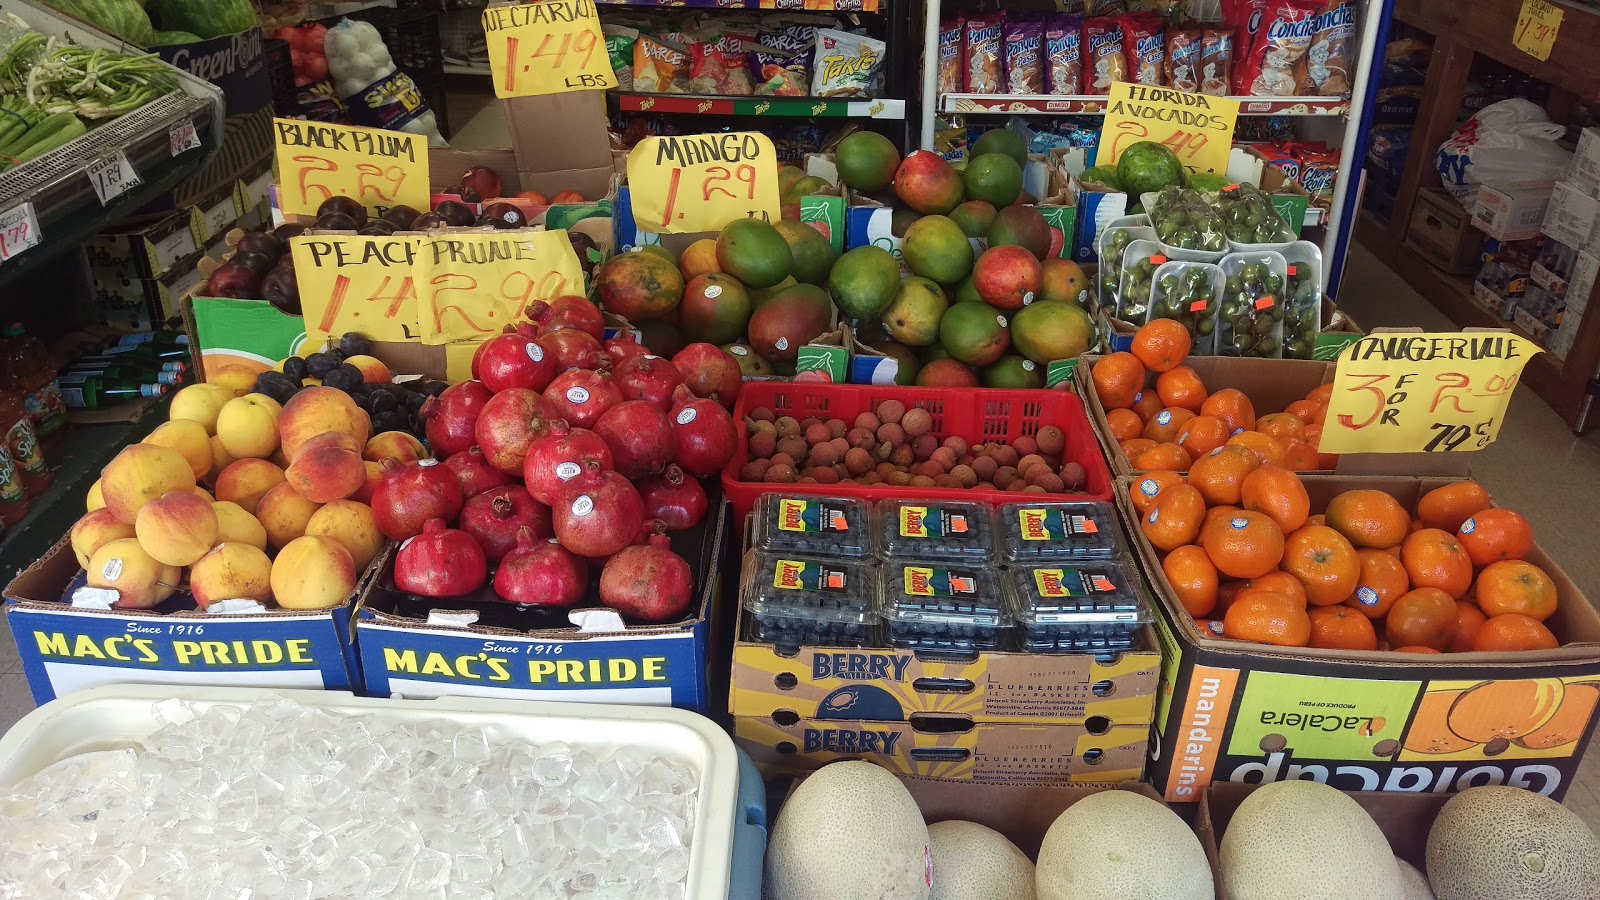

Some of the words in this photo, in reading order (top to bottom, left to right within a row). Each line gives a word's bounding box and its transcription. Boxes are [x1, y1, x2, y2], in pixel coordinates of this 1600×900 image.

[483, 0, 597, 32] NECTARINE
[1267, 15, 1314, 41] Concha
[1314, 3, 1355, 33] onchas
[940, 46, 958, 58] Nuez
[1007, 33, 1042, 62] Panqué
[1089, 26, 1123, 53] Panqué
[504, 28, 597, 92] 1.49
[821, 52, 880, 86] Takis
[1017, 53, 1037, 67] Pasas
[565, 74, 608, 88] LBS
[1128, 85, 1211, 110] FLORIDA
[1109, 100, 1228, 131] AVOCADOS
[275, 121, 349, 151] BLACK
[347, 131, 415, 163] PLUM
[90, 154, 119, 175] CELERY
[655, 134, 760, 168] MANGO
[292, 155, 407, 205] 2.29
[661, 163, 757, 228] 1.29
[423, 239, 536, 266] PRUNE
[318, 274, 418, 333] 1.4
[1350, 336, 1521, 362] TANGERINE
[1337, 373, 1391, 431] 3
[786, 502, 802, 530] BERRY
[906, 509, 922, 536] BERRY
[1026, 512, 1046, 538] BERRY
[781, 563, 800, 588] BERRY
[912, 569, 929, 594] BERRY
[1041, 571, 1065, 596] BERRY
[126, 622, 162, 635] Since
[168, 623, 204, 635] 1916
[33, 629, 160, 664] MAC'S
[172, 638, 314, 665] PRIDE
[482, 641, 520, 655] Since
[526, 644, 564, 655] 1916
[383, 647, 512, 682] MAC'S
[528, 656, 667, 684] PRIDE
[812, 653, 914, 684] BERRY
[1260, 711, 1374, 733] LaCalera
[803, 728, 902, 757] BERRY
[1175, 676, 1223, 797] mandarins
